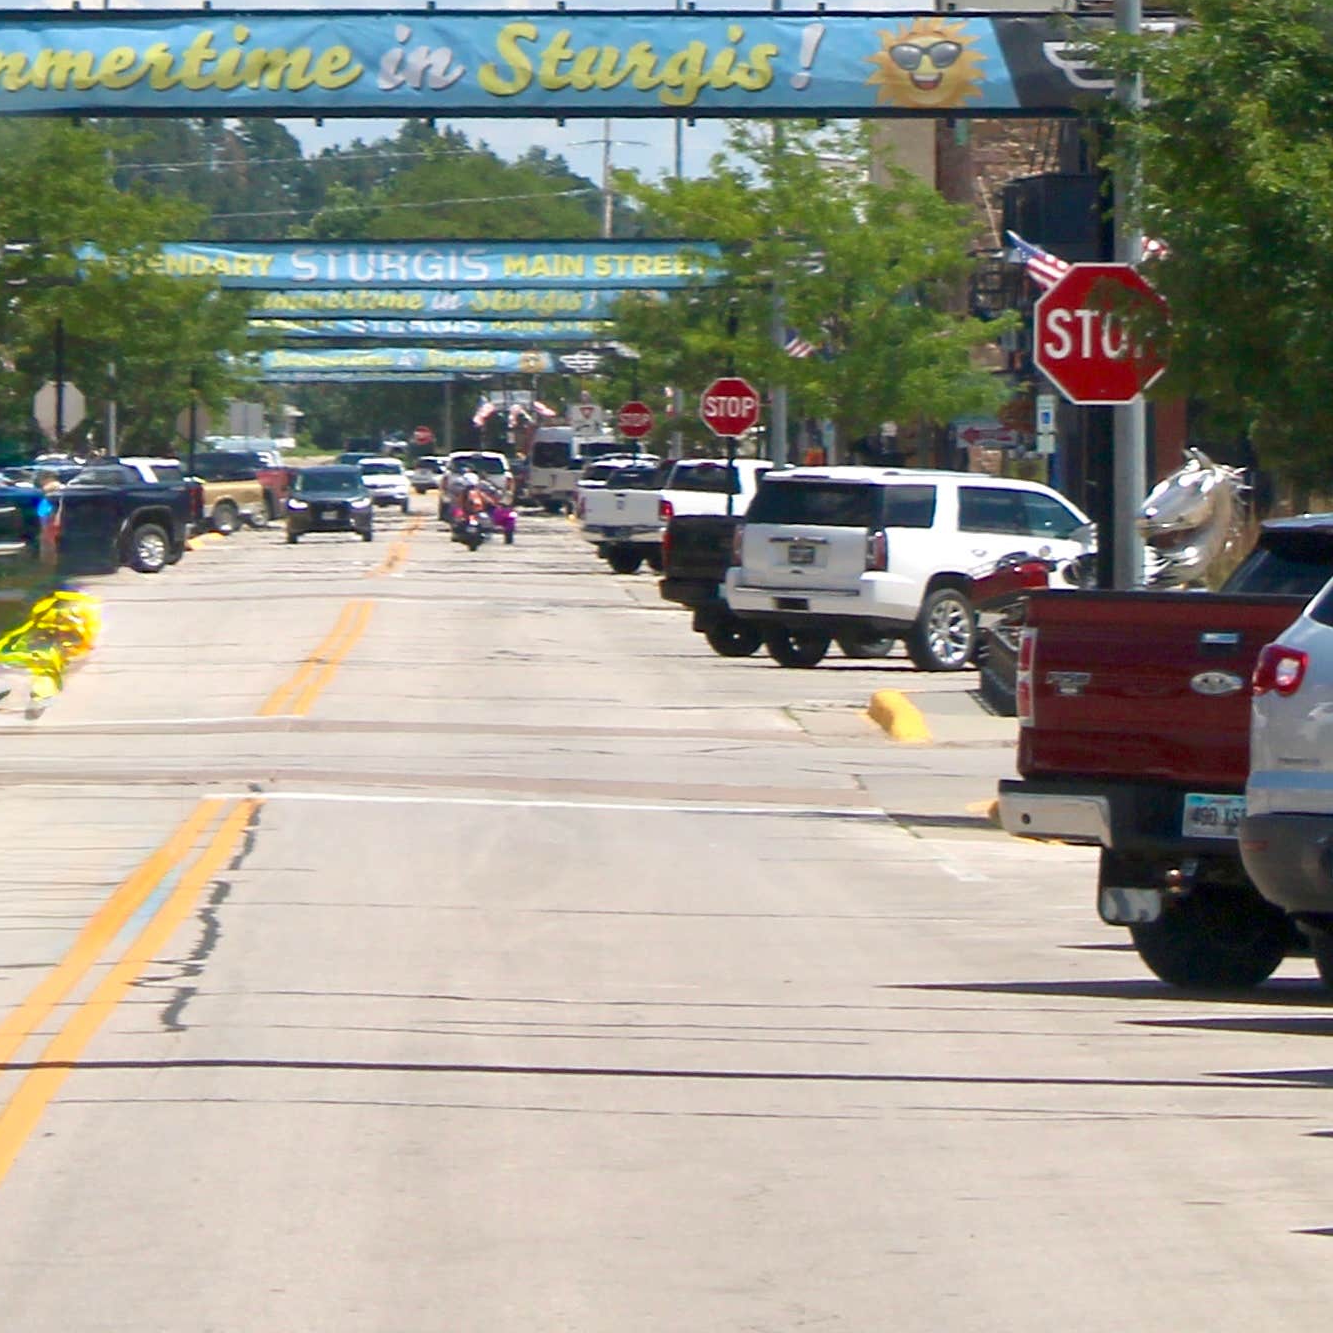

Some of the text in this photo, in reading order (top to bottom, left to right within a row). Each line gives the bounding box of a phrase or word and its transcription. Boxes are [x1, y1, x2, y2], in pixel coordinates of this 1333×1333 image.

[377, 24, 465, 91] in
[290, 248, 490, 282] STURGIS
[503, 253, 584, 277] MAIN
[1045, 308, 1146, 360] STO
[704, 396, 756, 418] STOP
